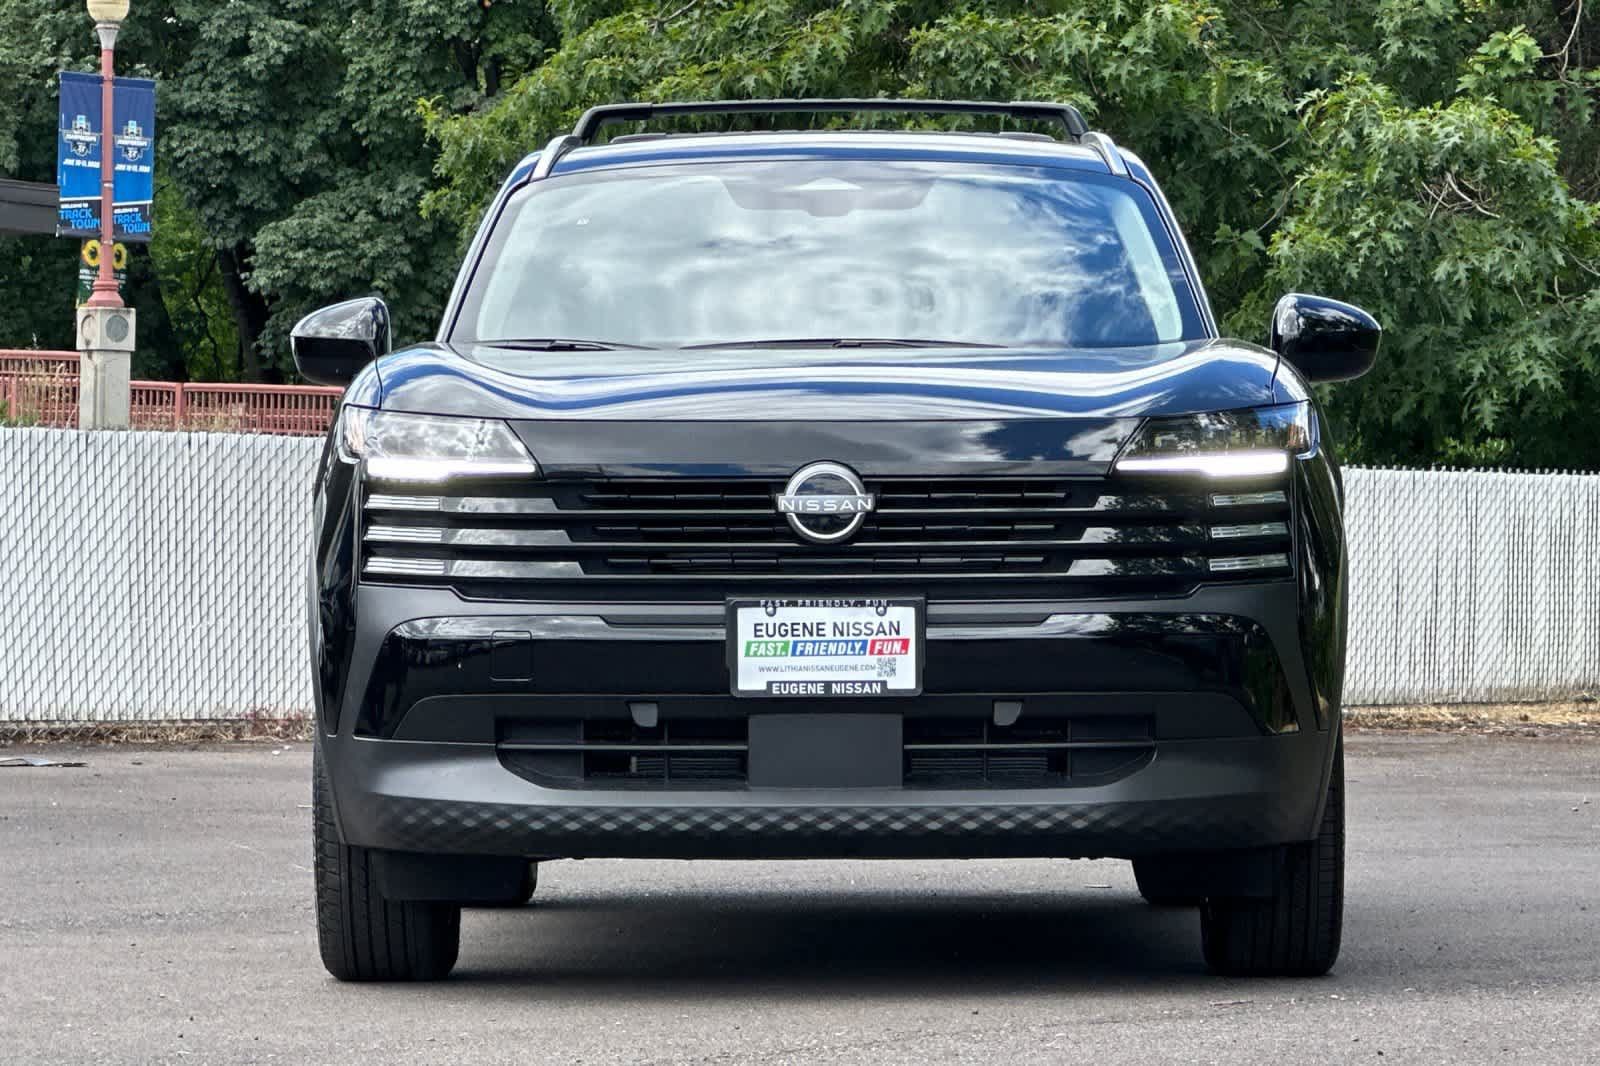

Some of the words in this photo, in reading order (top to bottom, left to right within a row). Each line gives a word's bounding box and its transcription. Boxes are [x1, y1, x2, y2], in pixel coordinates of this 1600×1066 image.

[59, 207, 92, 220] TRACK
[112, 212, 142, 225] TRACK
[70, 218, 100, 230] TOWN
[122, 221, 151, 233] TOWN
[780, 498, 872, 512] NISSAN
[753, 622, 827, 638] EUGENE
[832, 620, 901, 637] NISSAN
[749, 642, 787, 656] FAST.
[795, 641, 865, 656] FRIENDLY.
[873, 640, 907, 654] FUN.
[771, 682, 825, 695] EUGENE
[831, 682, 881, 694] NISSAN
